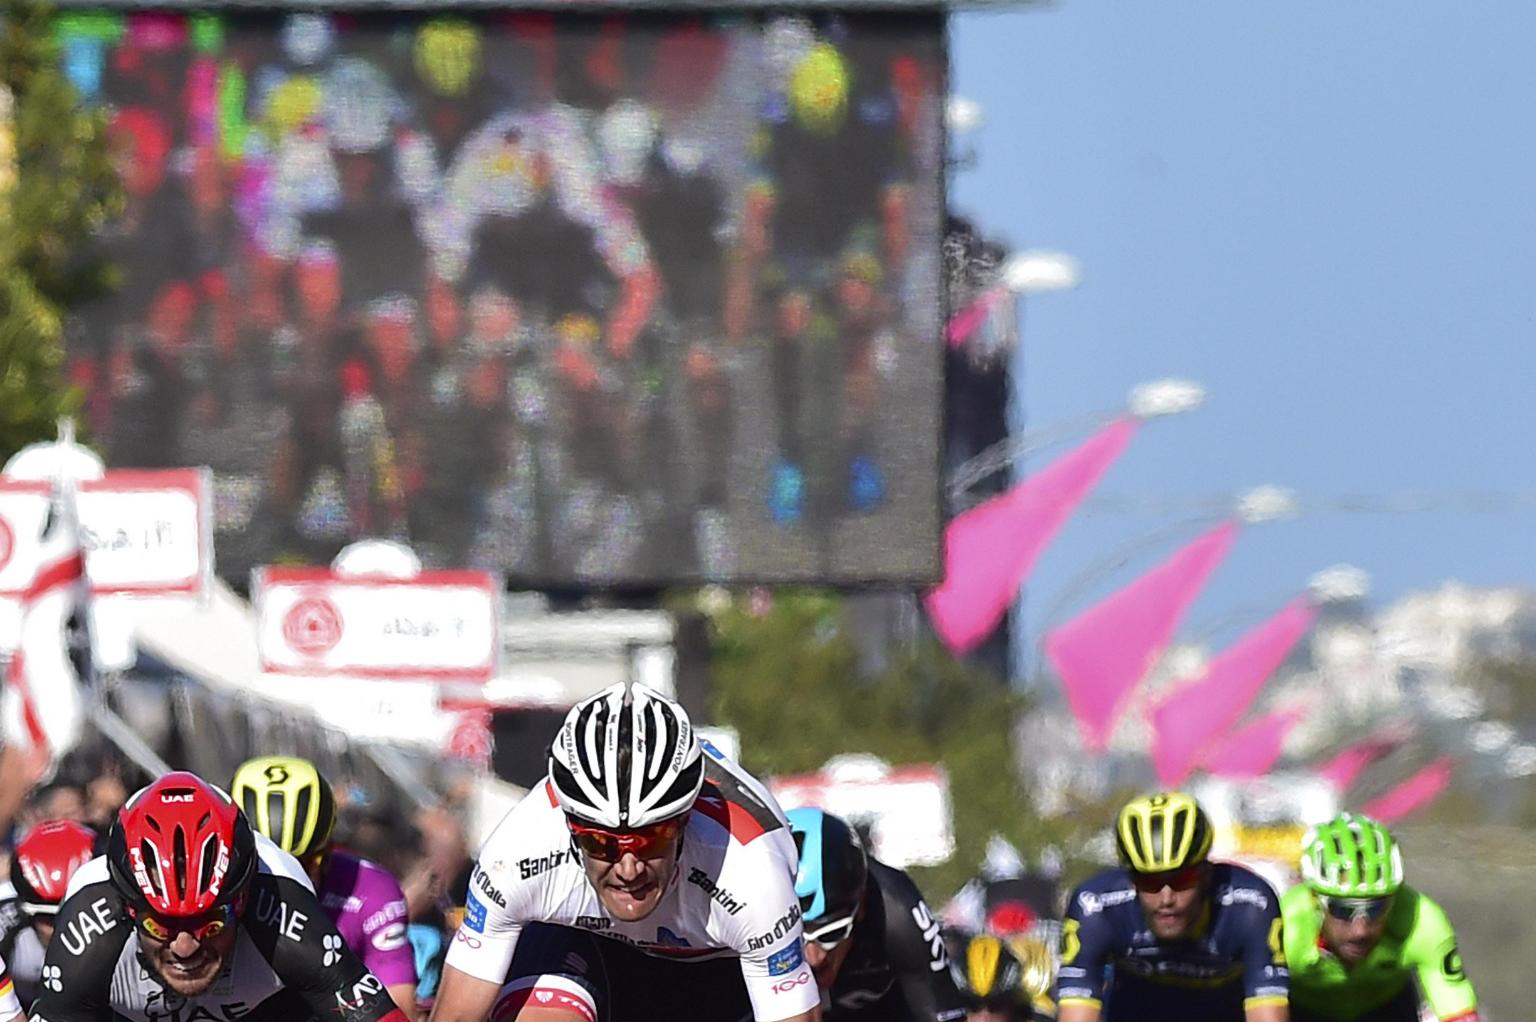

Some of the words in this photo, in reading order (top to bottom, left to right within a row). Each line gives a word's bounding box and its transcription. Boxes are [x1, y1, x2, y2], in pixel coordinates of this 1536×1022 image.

[161, 794, 194, 803] UAE
[130, 847, 156, 898] MET
[209, 840, 229, 896] MET
[687, 866, 748, 916] Santini
[60, 897, 117, 956] UAE
[259, 888, 309, 943] UAE
[748, 931, 774, 951] Giro
